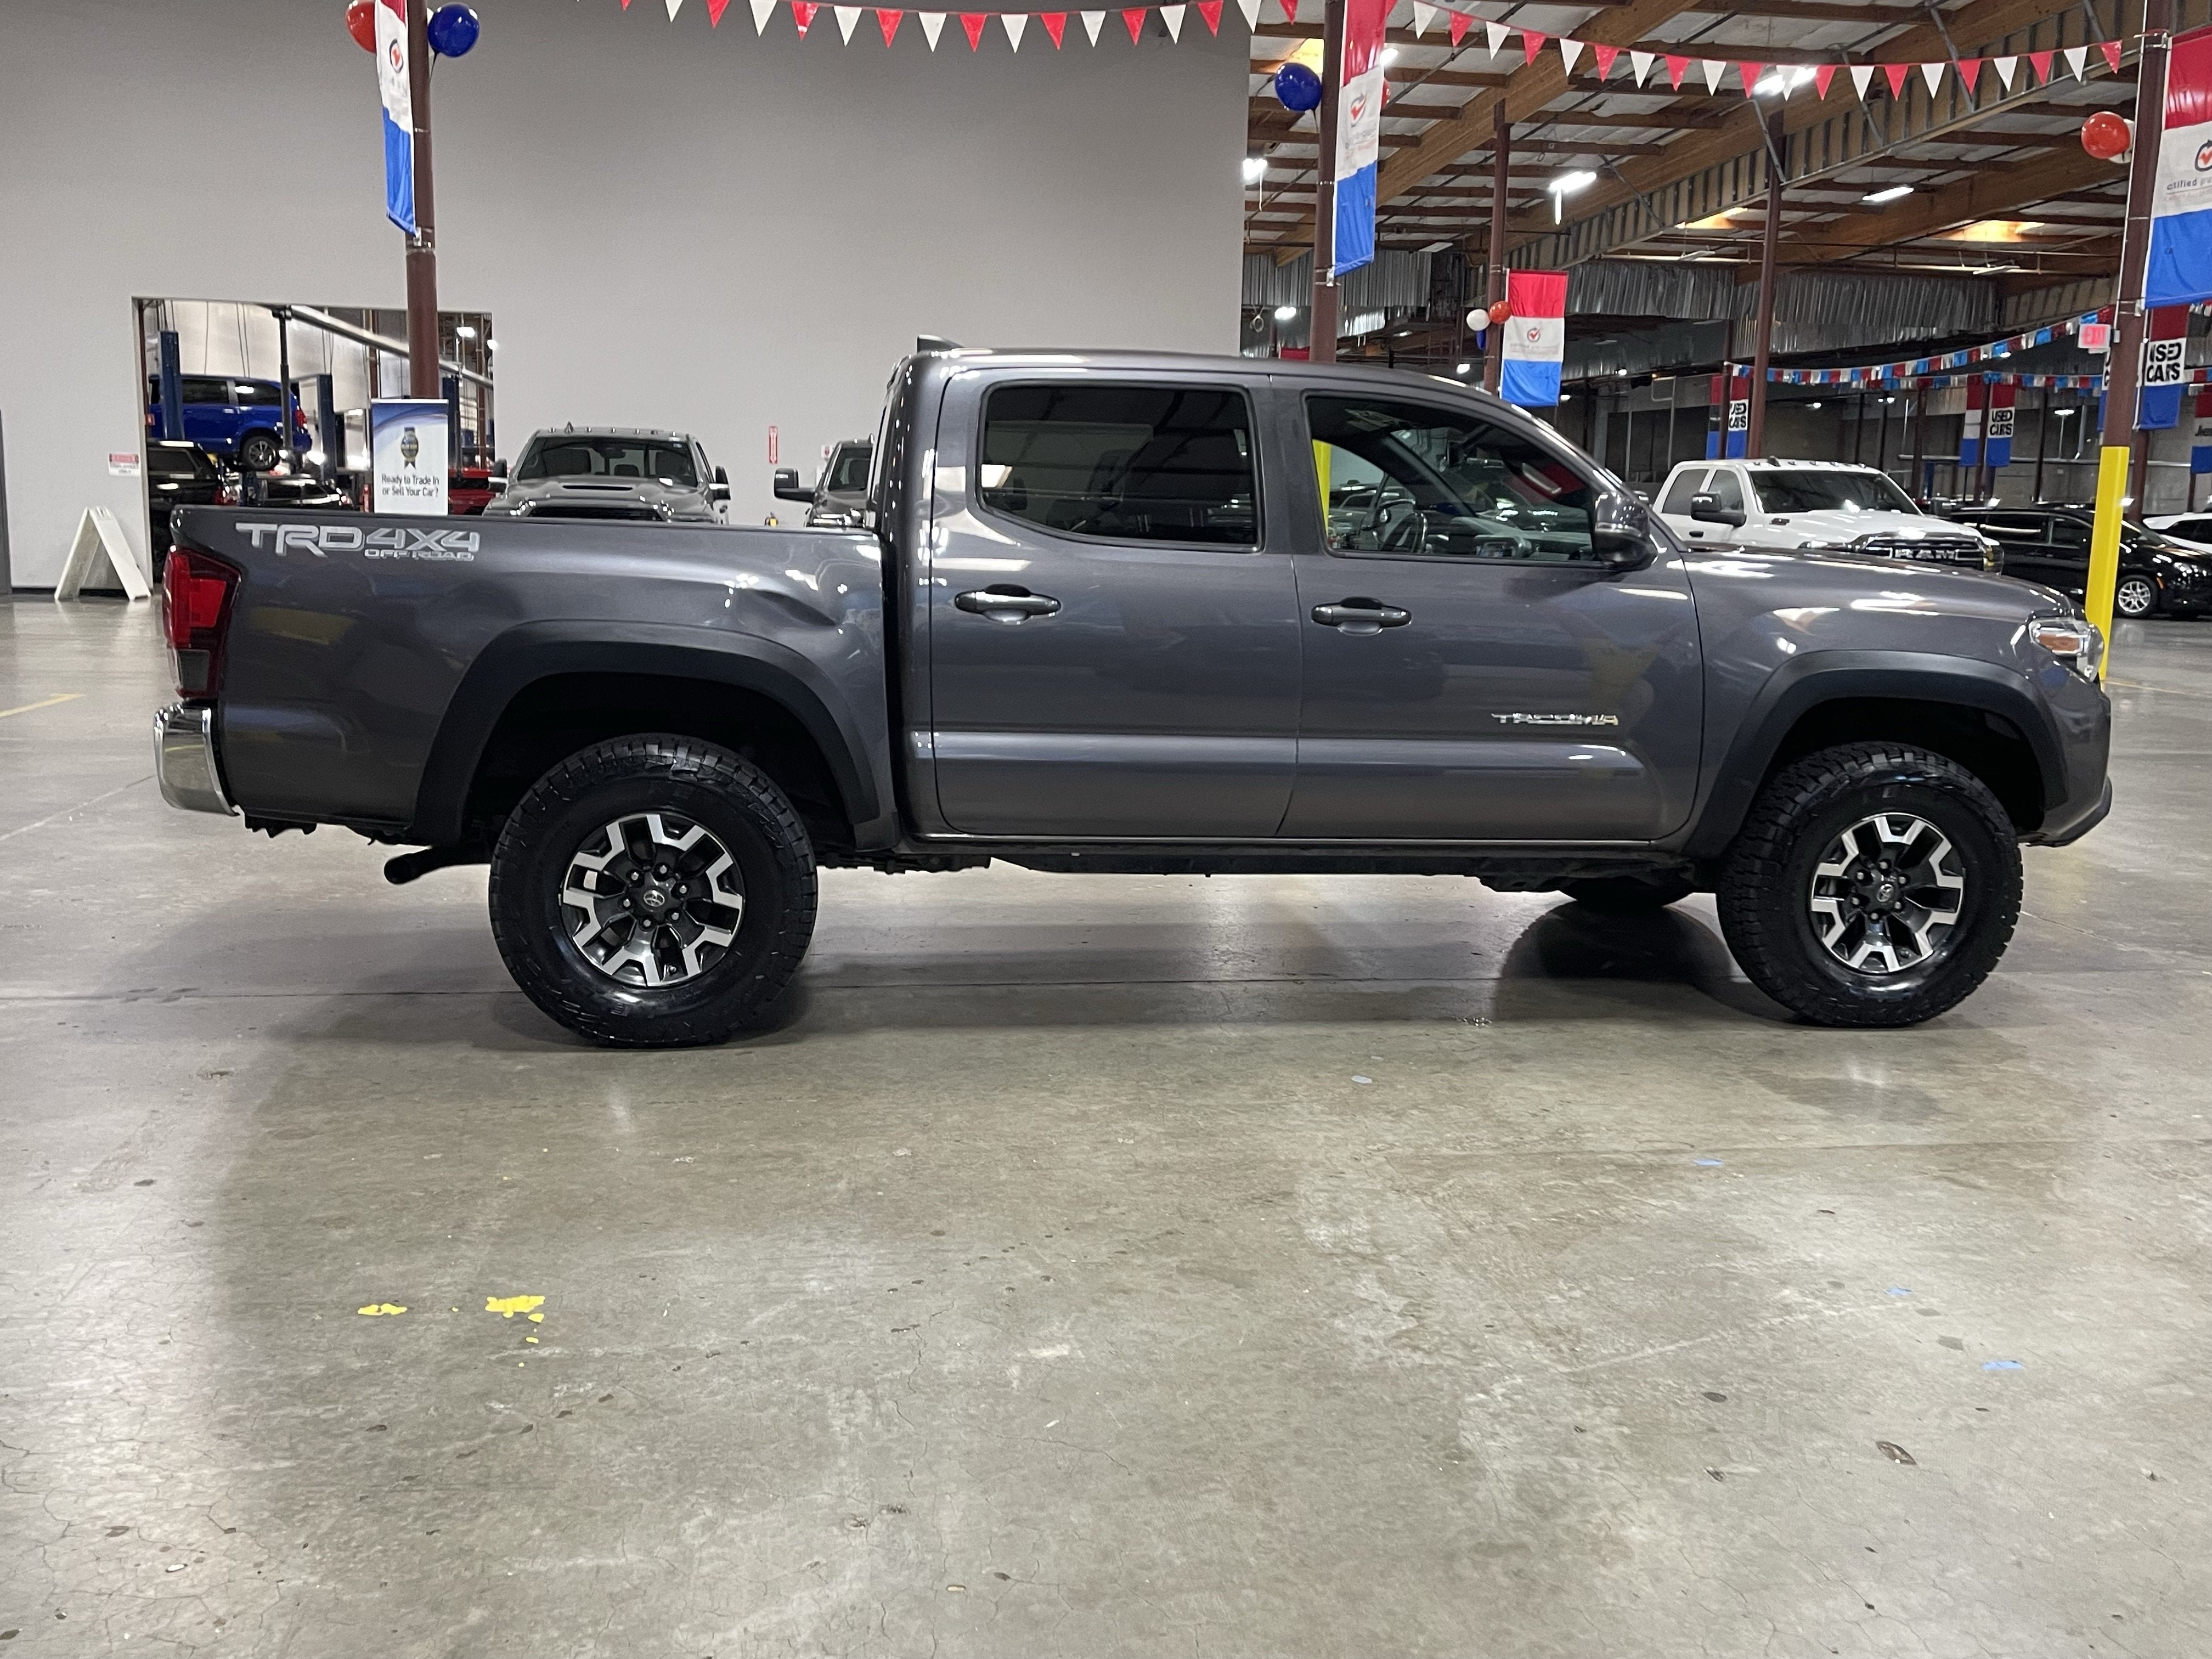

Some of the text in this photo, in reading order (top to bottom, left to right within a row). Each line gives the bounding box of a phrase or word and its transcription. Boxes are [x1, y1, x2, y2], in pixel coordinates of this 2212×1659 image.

[382, 473, 439, 486] Ready to Trade In
[392, 485, 404, 496] Sell
[405, 486, 421, 496] Your
[422, 487, 439, 497] Car?
[235, 522, 365, 557] TRD
[364, 549, 475, 562] OFF ROAD
[1894, 549, 1956, 560] RAM
